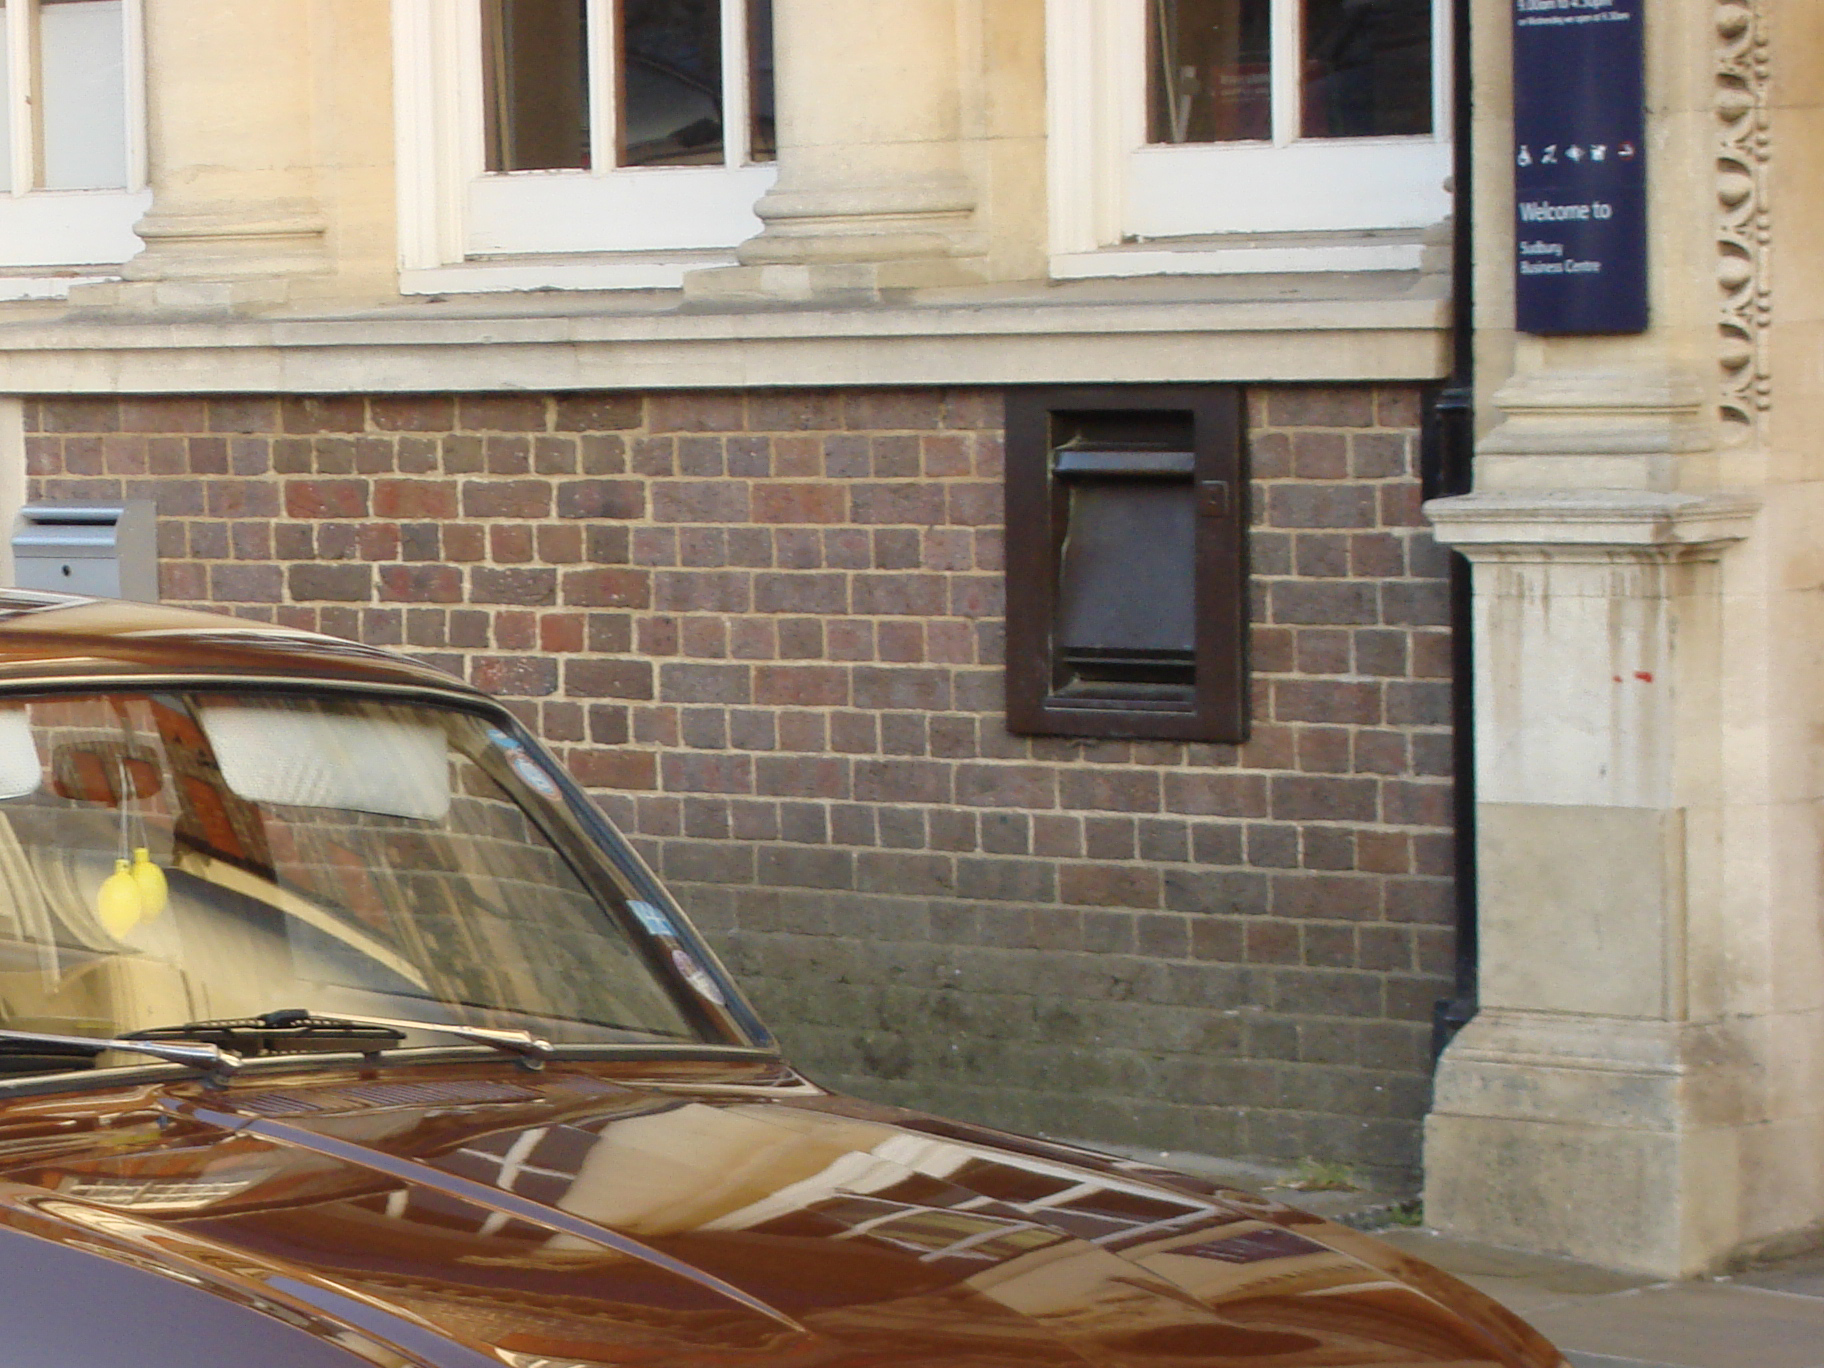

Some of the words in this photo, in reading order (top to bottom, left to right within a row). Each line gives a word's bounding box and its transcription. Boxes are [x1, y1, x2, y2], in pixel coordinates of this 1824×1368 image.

[1518, 201, 1590, 222] Welcome
[1592, 201, 1612, 220] to
[1519, 260, 1563, 275] Business
[1564, 259, 1601, 274] Centre
